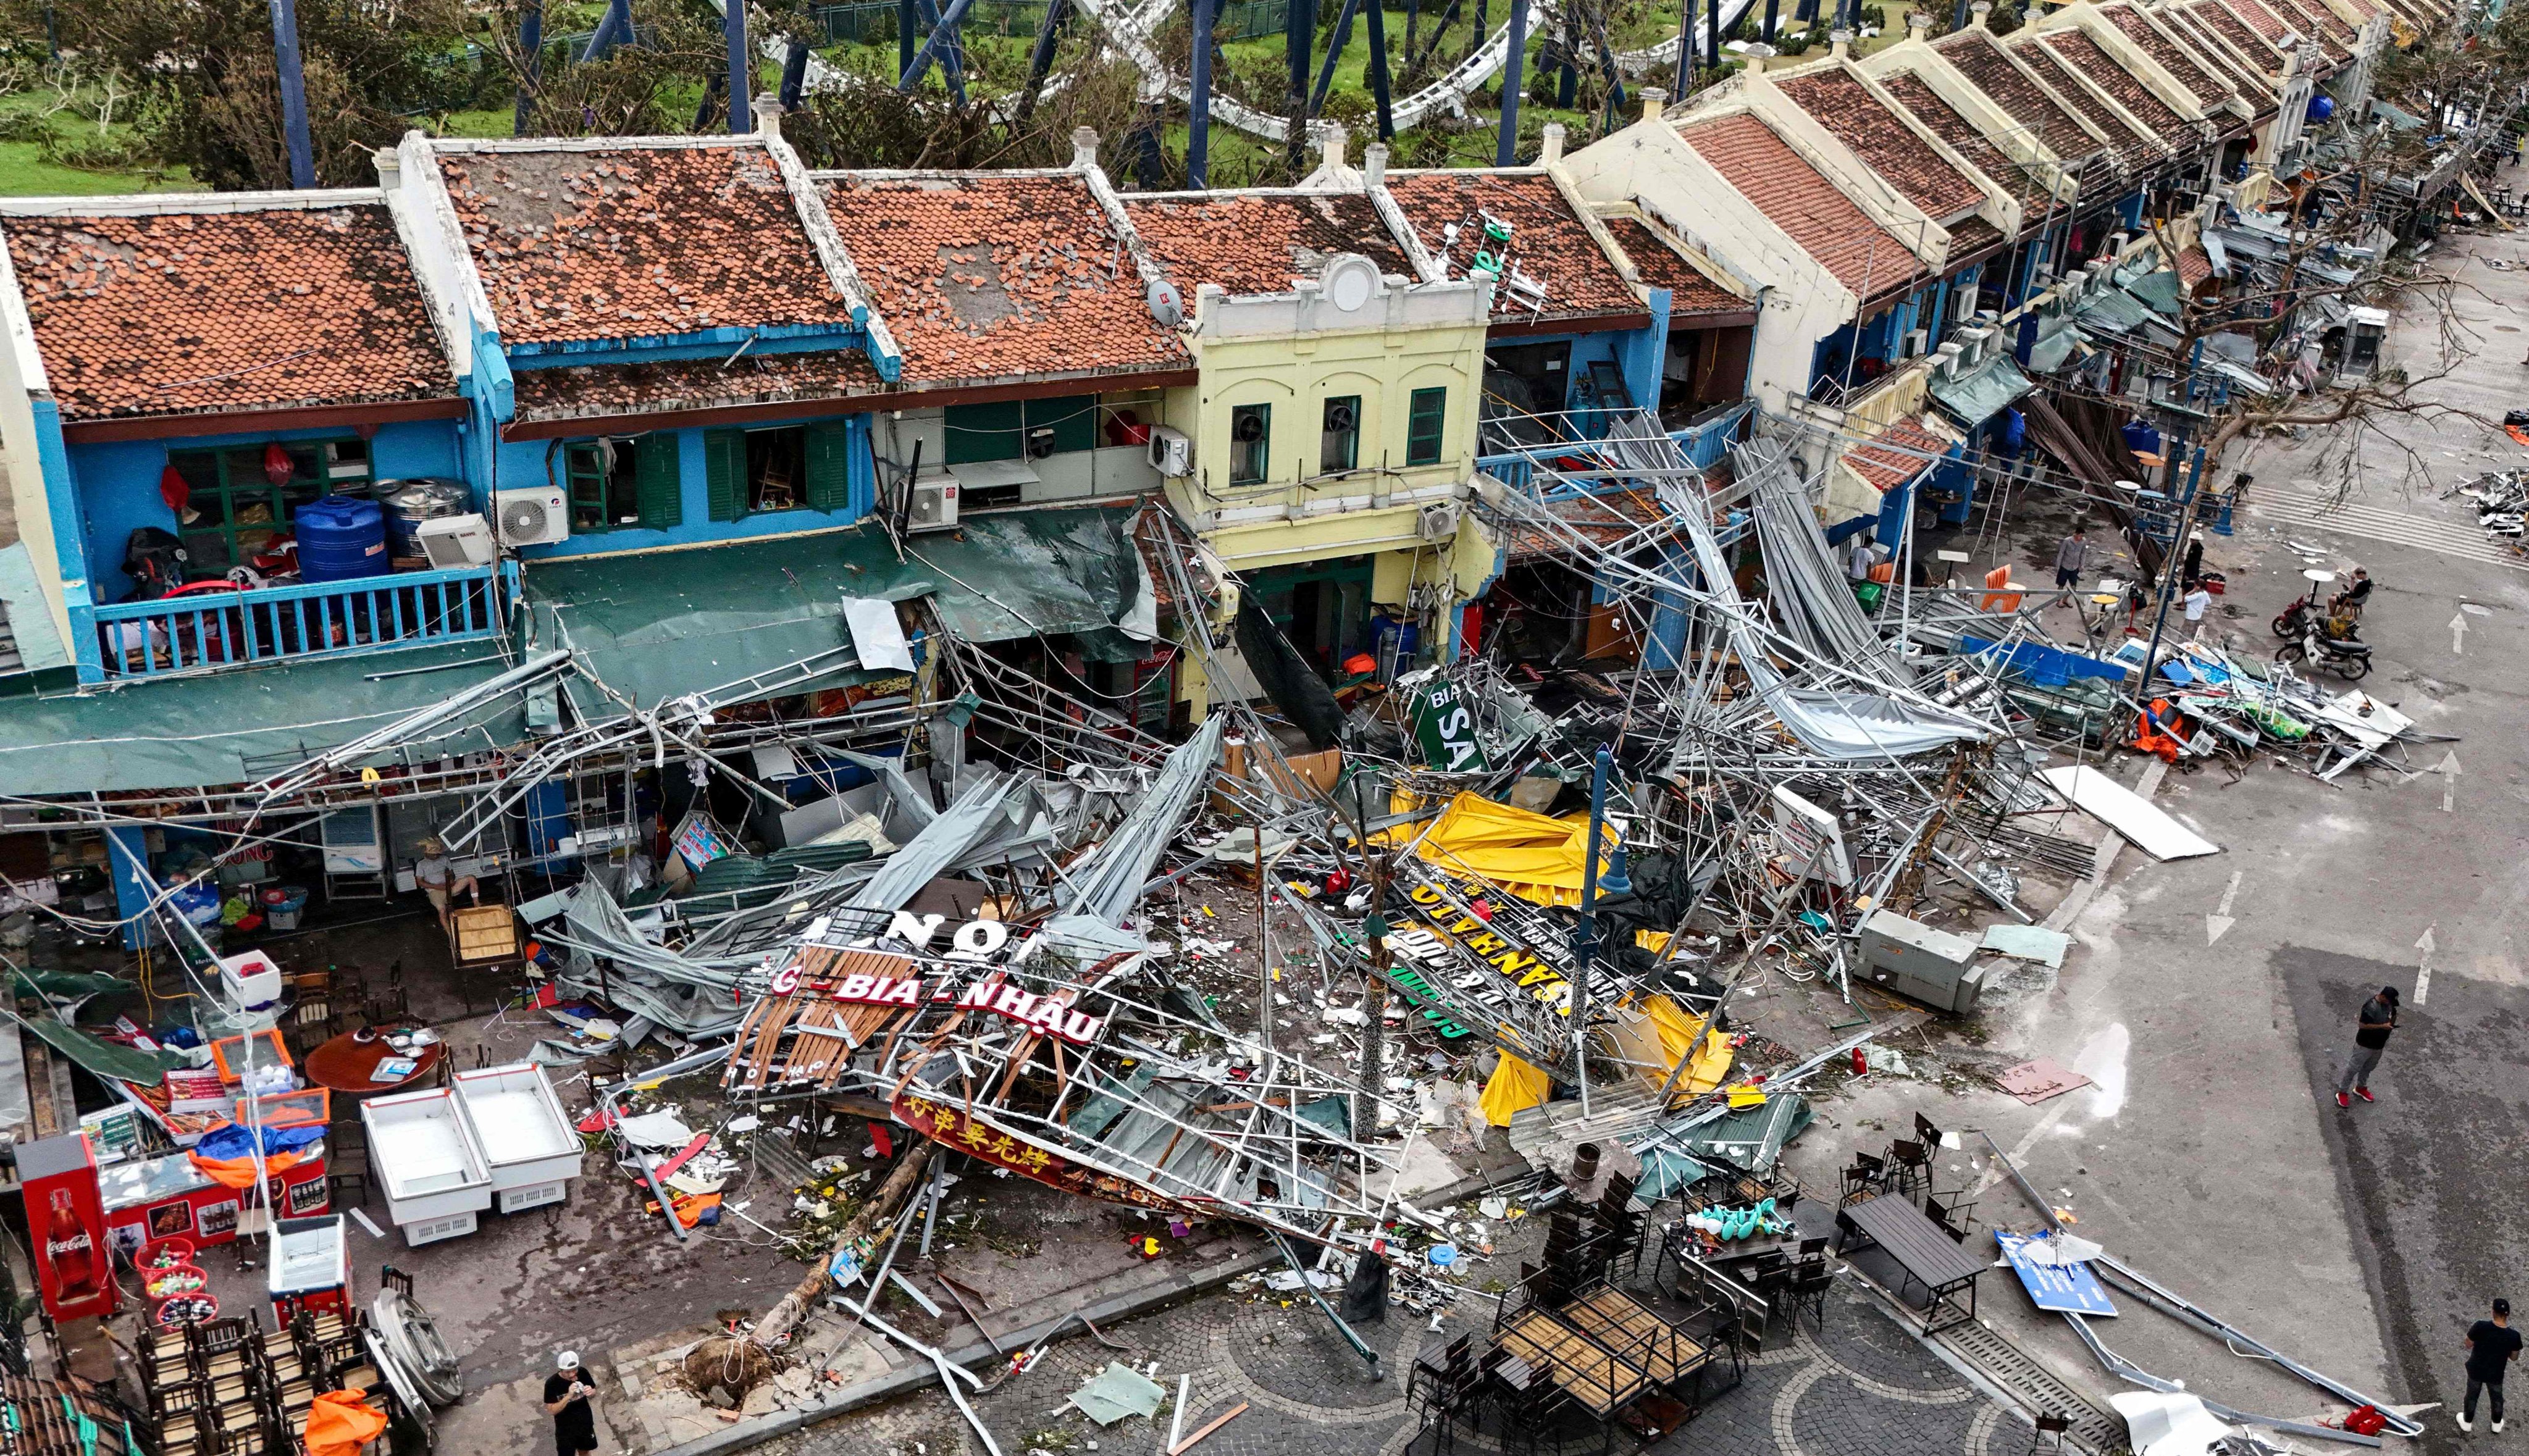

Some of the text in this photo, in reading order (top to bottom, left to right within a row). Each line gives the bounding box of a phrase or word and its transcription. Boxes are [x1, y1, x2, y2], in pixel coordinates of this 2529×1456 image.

[1430, 685, 1461, 709] BIA
[1438, 707, 1480, 772] SA
[833, 974, 923, 1008] BIA
[956, 982, 1104, 1044] NHẬU
[47, 1234, 91, 1255] Coca-Cola
